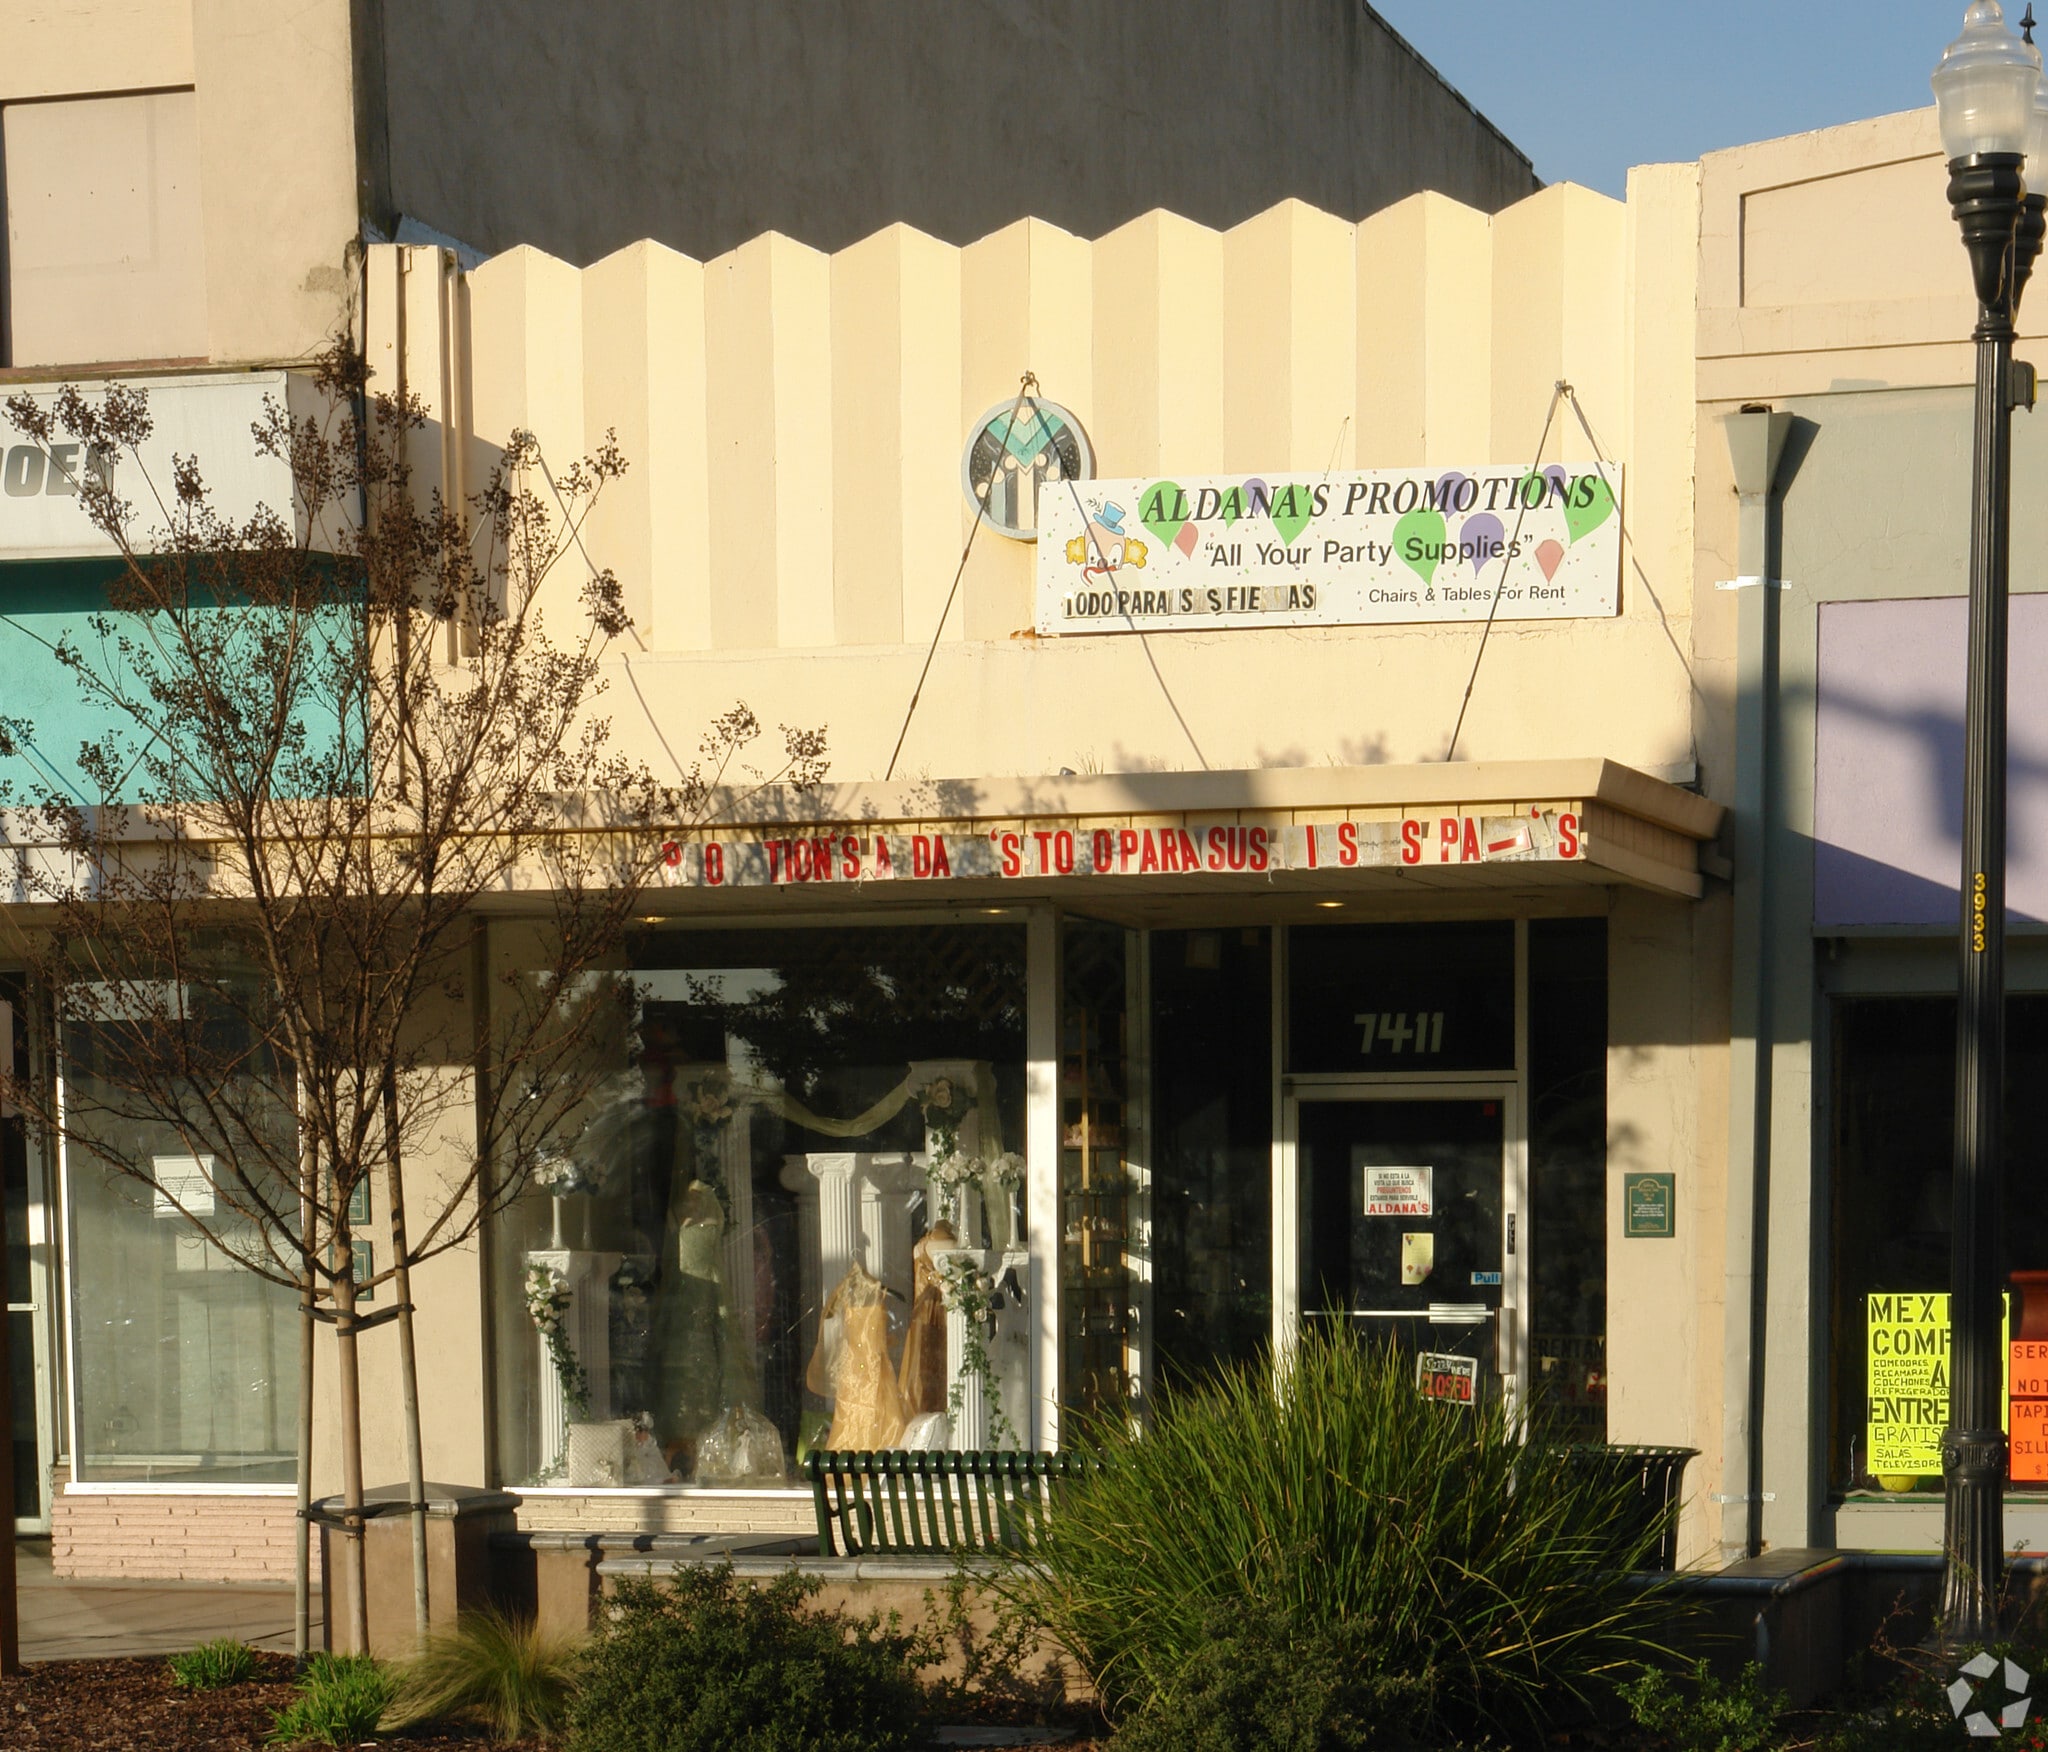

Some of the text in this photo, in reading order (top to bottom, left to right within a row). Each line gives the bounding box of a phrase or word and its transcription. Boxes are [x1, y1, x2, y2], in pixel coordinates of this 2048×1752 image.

[1141, 474, 1598, 523] ALDANA'S PROMOTIONS
[1256, 542, 1312, 566] Your
[1324, 540, 1392, 567] Party
[1118, 590, 1167, 614] PARA
[1369, 584, 1566, 603] Chairs & Tables For Rent
[1207, 826, 1268, 872] SUS
[1974, 872, 1986, 952] 3933
[1354, 1012, 1444, 1053] 7411
[1369, 1201, 1429, 1213] ALDANA'S
[1474, 1273, 1499, 1283] Pull
[2014, 1345, 2048, 1359] SER
[1873, 1359, 1929, 1368] COMEDORES
[1873, 1369, 1929, 1378] RECAMARAS
[1873, 1378, 1931, 1387] COLCHONES
[1868, 1397, 1950, 1425] ENTRE
[1874, 1426, 1942, 1444] GRATIS
[1876, 1449, 1912, 1459] SALAS
